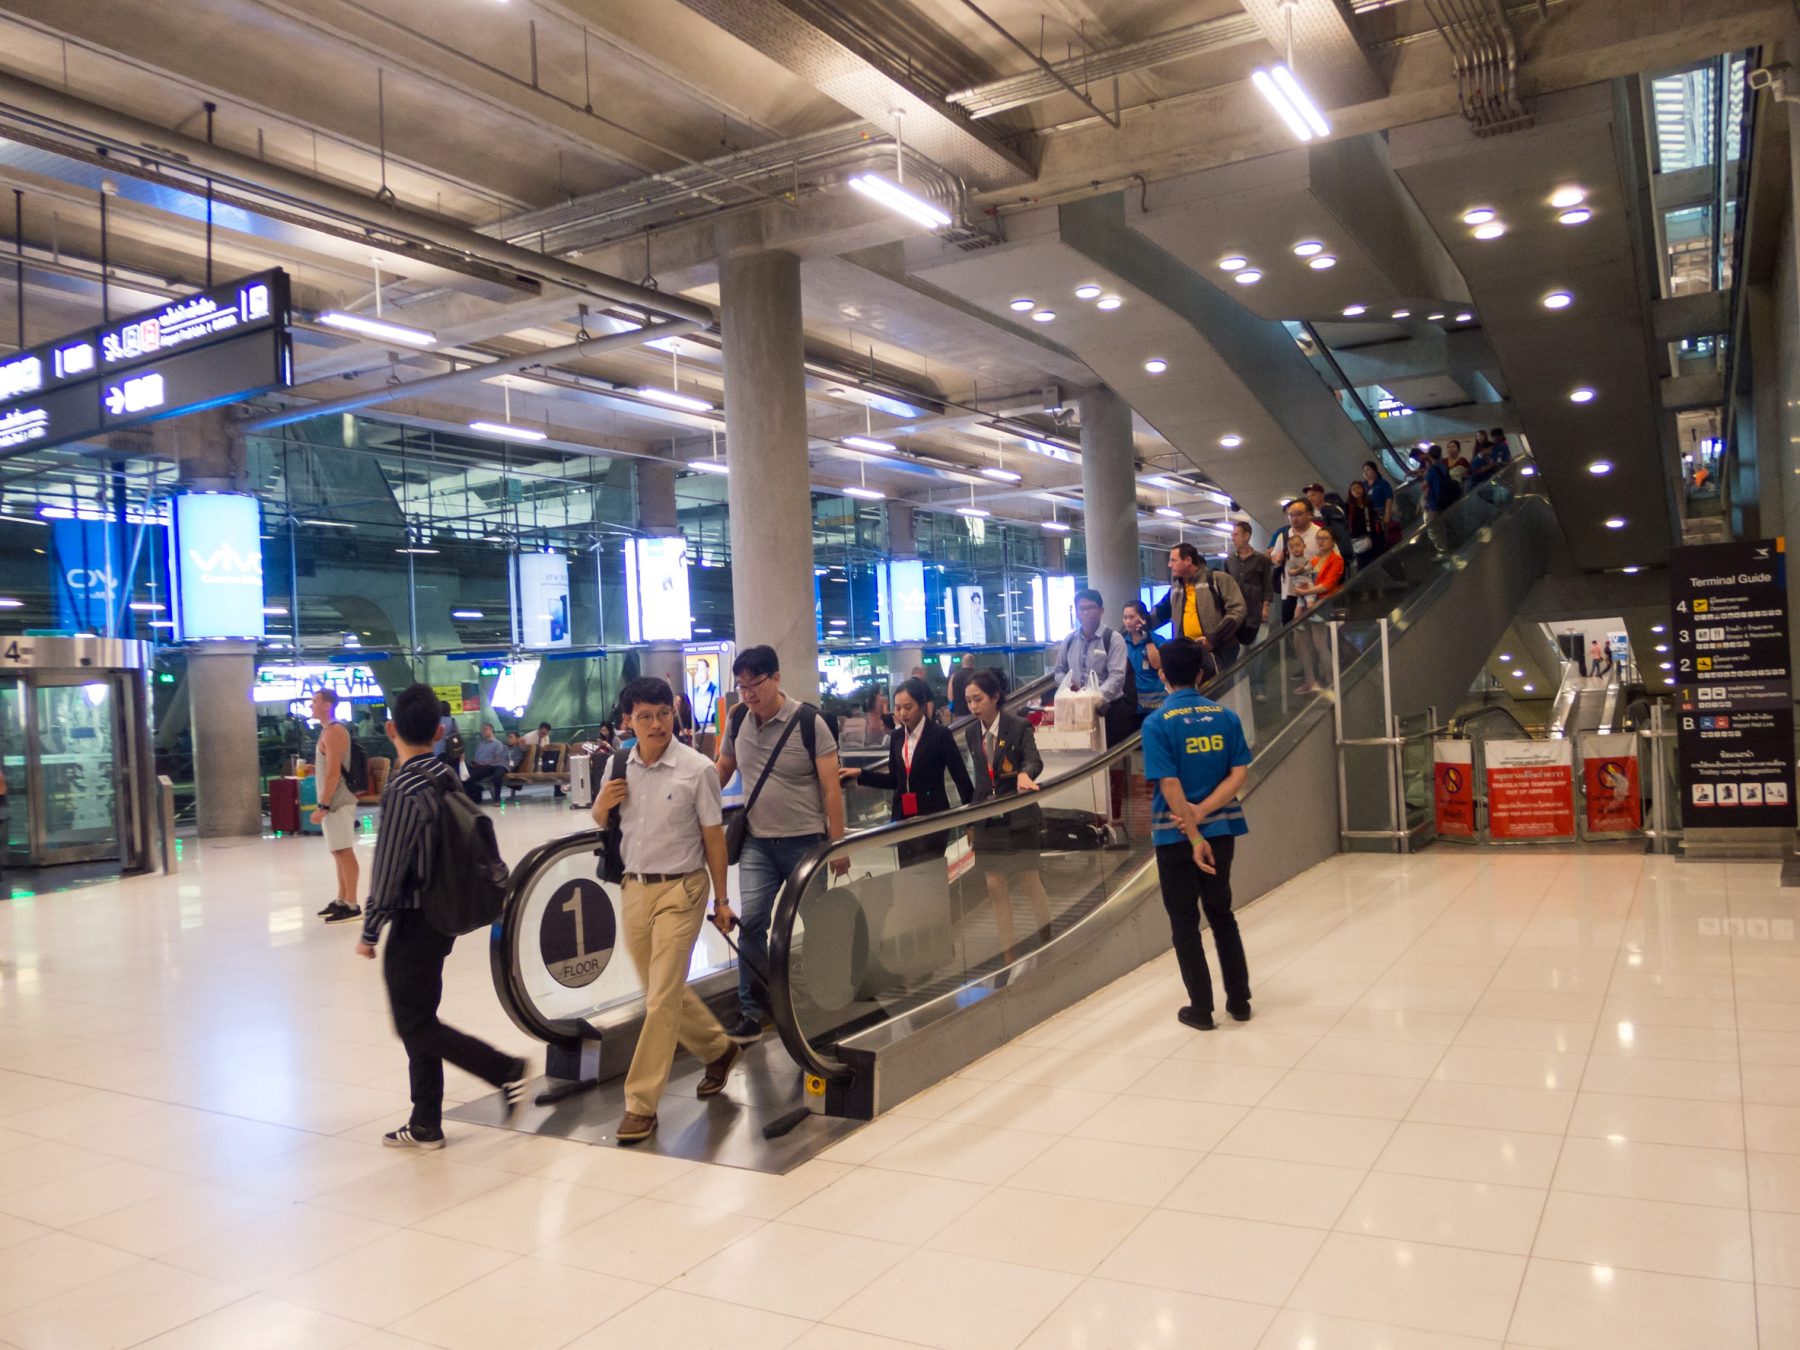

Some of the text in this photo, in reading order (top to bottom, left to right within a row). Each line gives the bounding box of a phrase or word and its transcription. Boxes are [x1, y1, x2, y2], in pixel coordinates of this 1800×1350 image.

[1690, 573, 1772, 587] Terminal Guide
[1676, 601, 1688, 613] 4
[1679, 630, 1690, 642] 3
[5, 641, 21, 662] 4
[1680, 659, 1691, 671] 2
[1682, 688, 1689, 700] 1
[1163, 707, 1192, 720] AIRPORT
[1683, 717, 1694, 730] B
[1185, 734, 1224, 754] 206
[1699, 768, 1720, 776] Trolley
[1742, 767, 1782, 775] suggestions
[562, 887, 585, 960] 1
[563, 959, 599, 977] FLOOR
